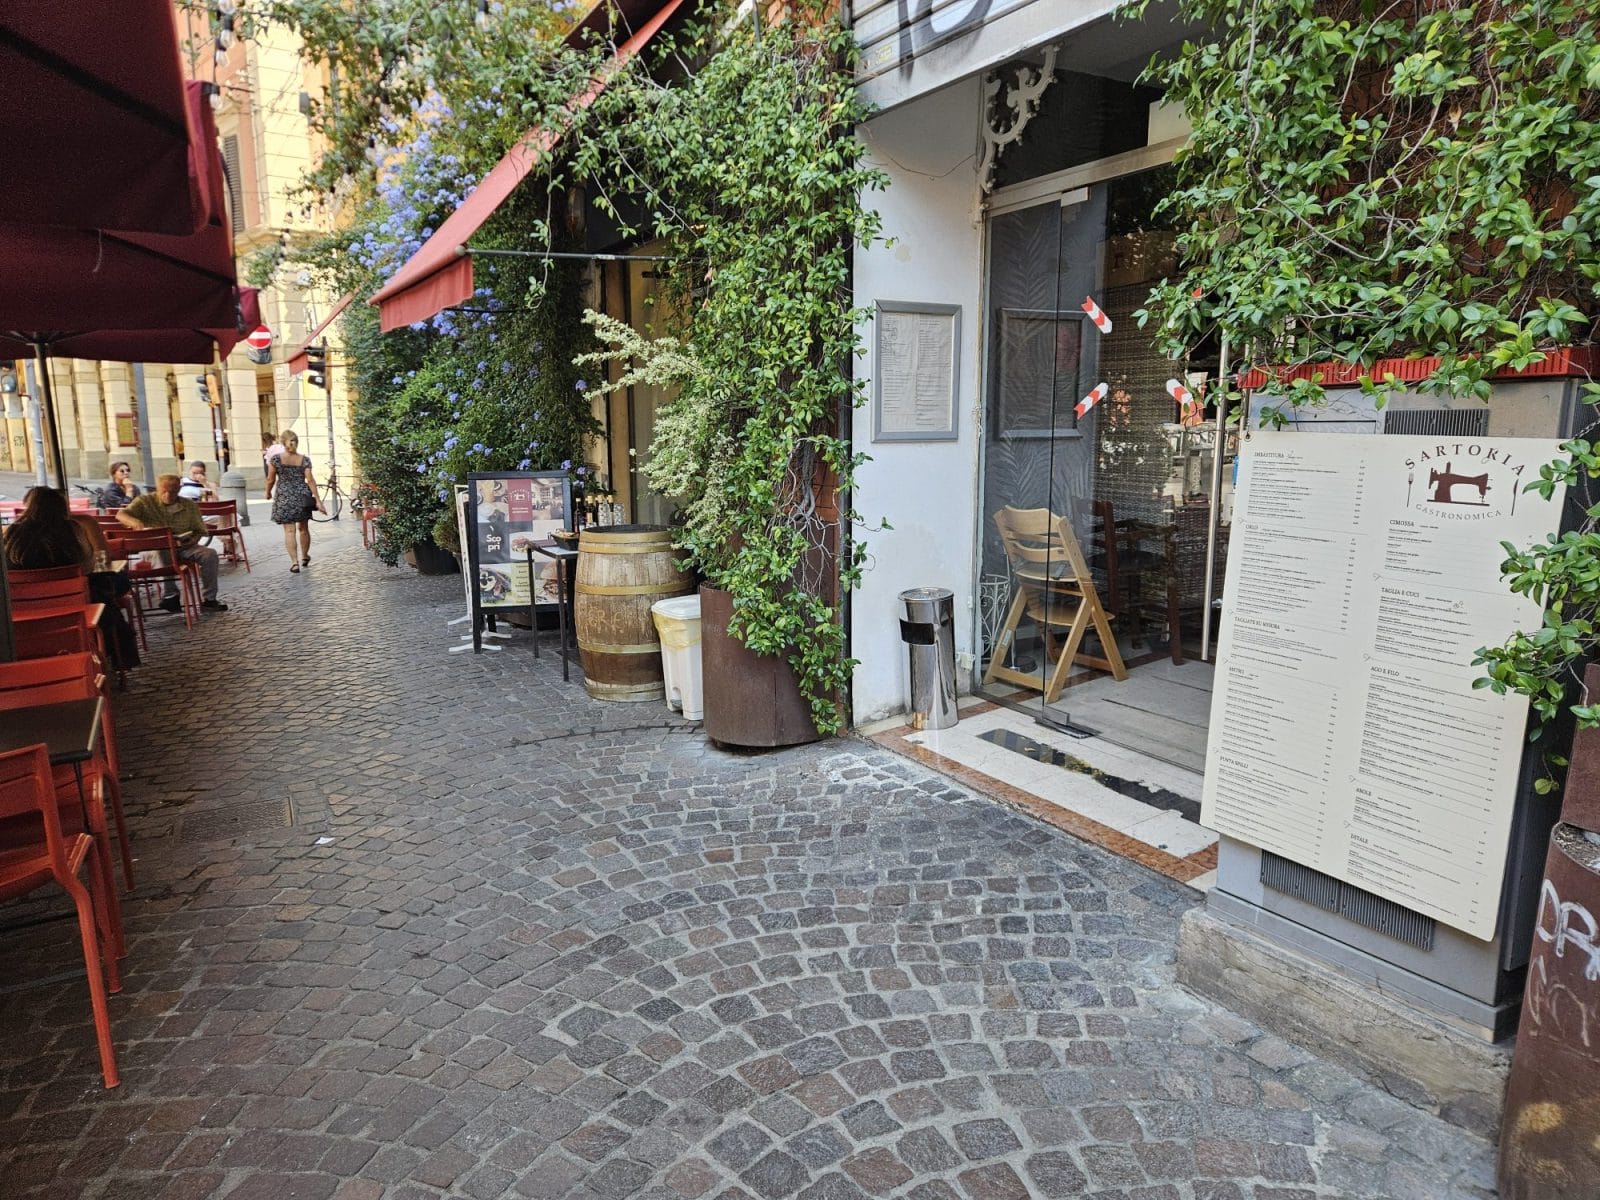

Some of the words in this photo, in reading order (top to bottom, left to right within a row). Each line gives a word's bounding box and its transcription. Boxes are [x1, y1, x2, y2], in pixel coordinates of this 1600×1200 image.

[1405, 444, 1525, 476] SARTORIA
[1415, 503, 1502, 520] GASTRONOMICA
[486, 534, 502, 543] Sco
[487, 542, 501, 552] pri
